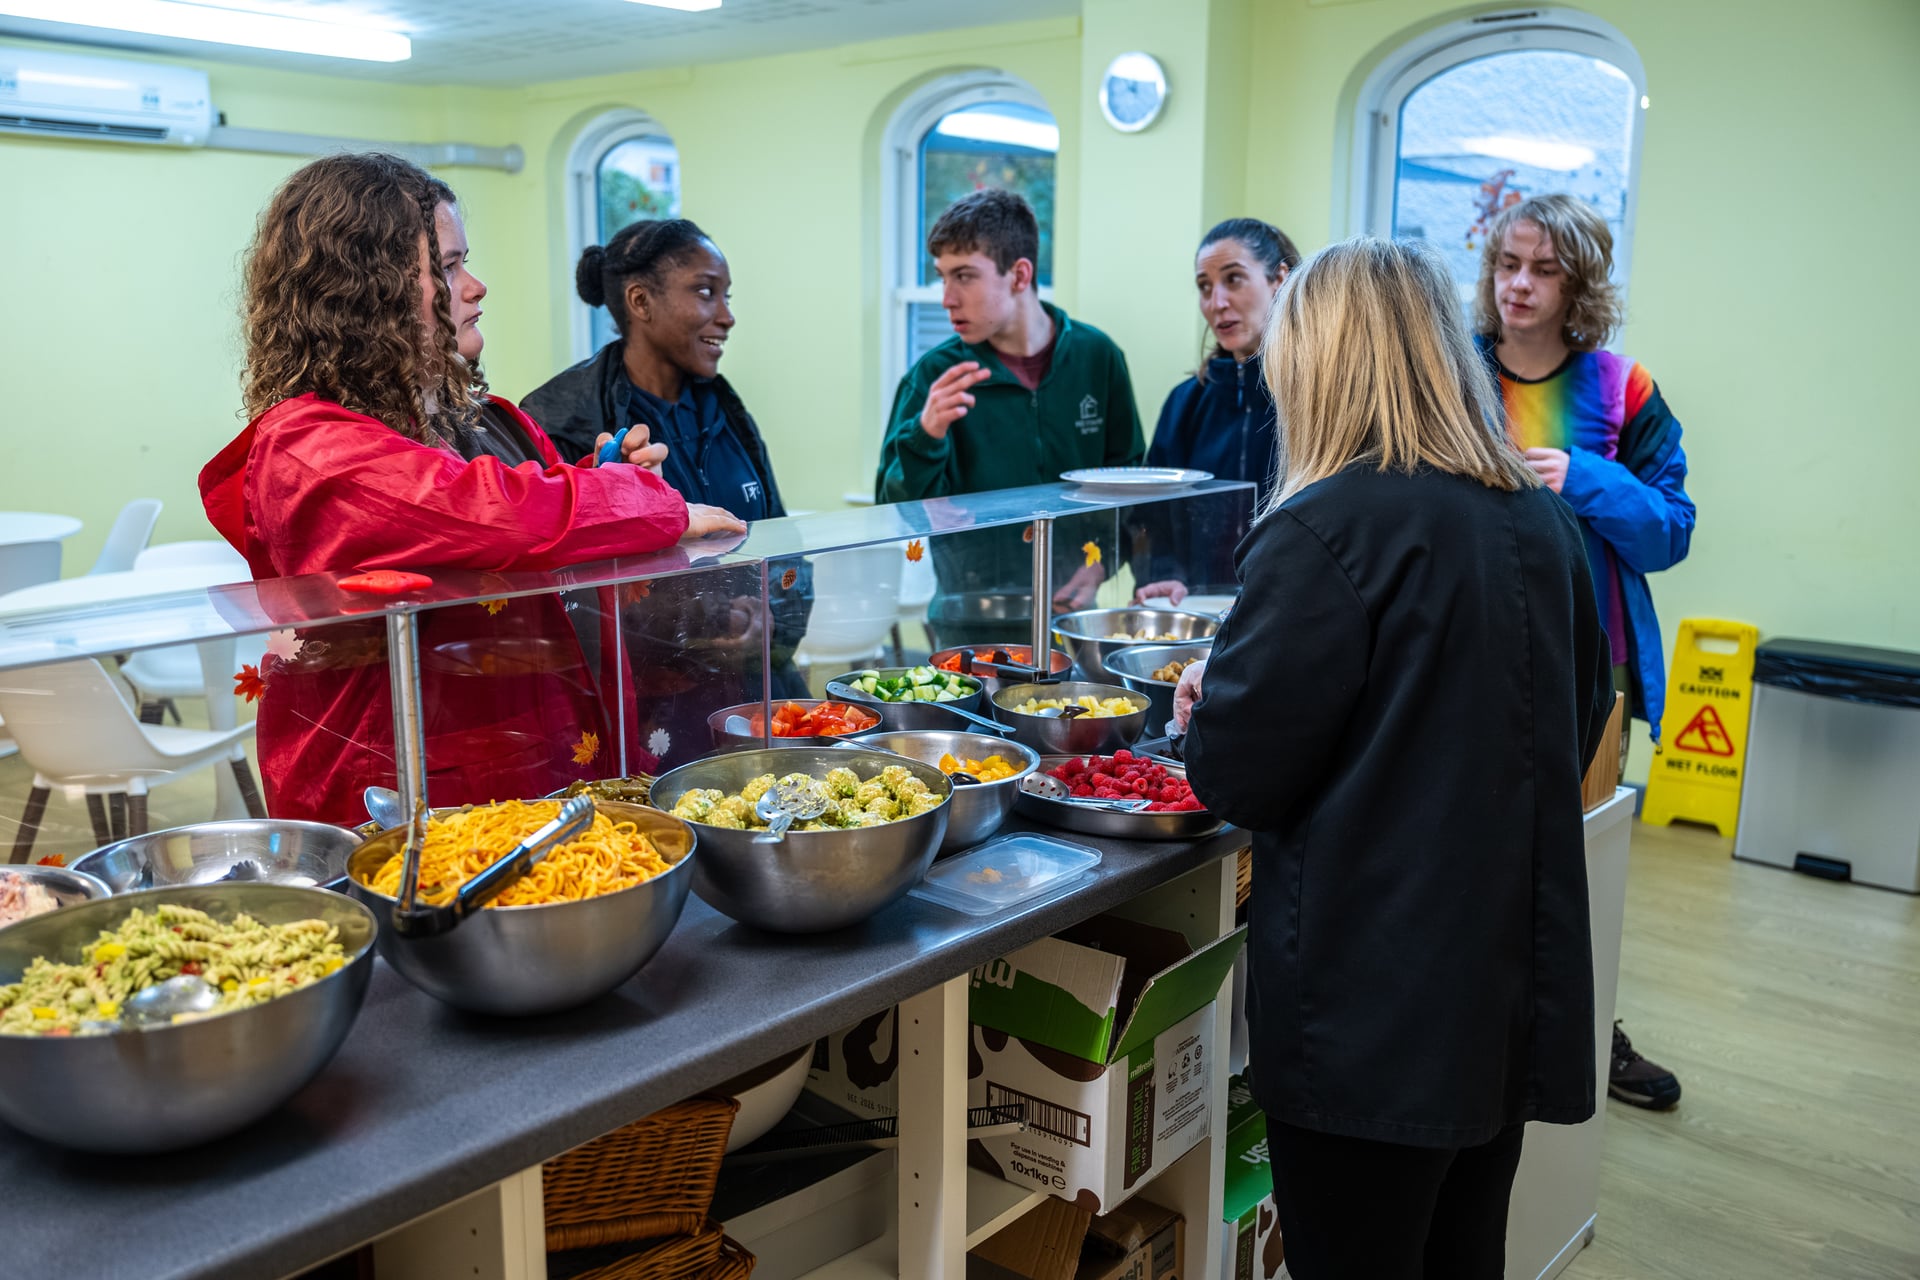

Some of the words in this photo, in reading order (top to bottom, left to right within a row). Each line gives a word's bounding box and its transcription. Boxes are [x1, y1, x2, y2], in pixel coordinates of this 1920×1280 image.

[1679, 683, 1740, 699] CAUTION
[1666, 759, 1691, 772] WET
[1697, 762, 1738, 778] FLOOR
[1132, 1084, 1145, 1141] ETHICAL
[1013, 1150, 1037, 1163] dispense
[1038, 1159, 1063, 1173] machines
[1038, 1152, 1060, 1166] vending
[1060, 1160, 1066, 1168] &
[1130, 1147, 1142, 1174] FAIR
[1010, 1160, 1049, 1186] 10x1kg
